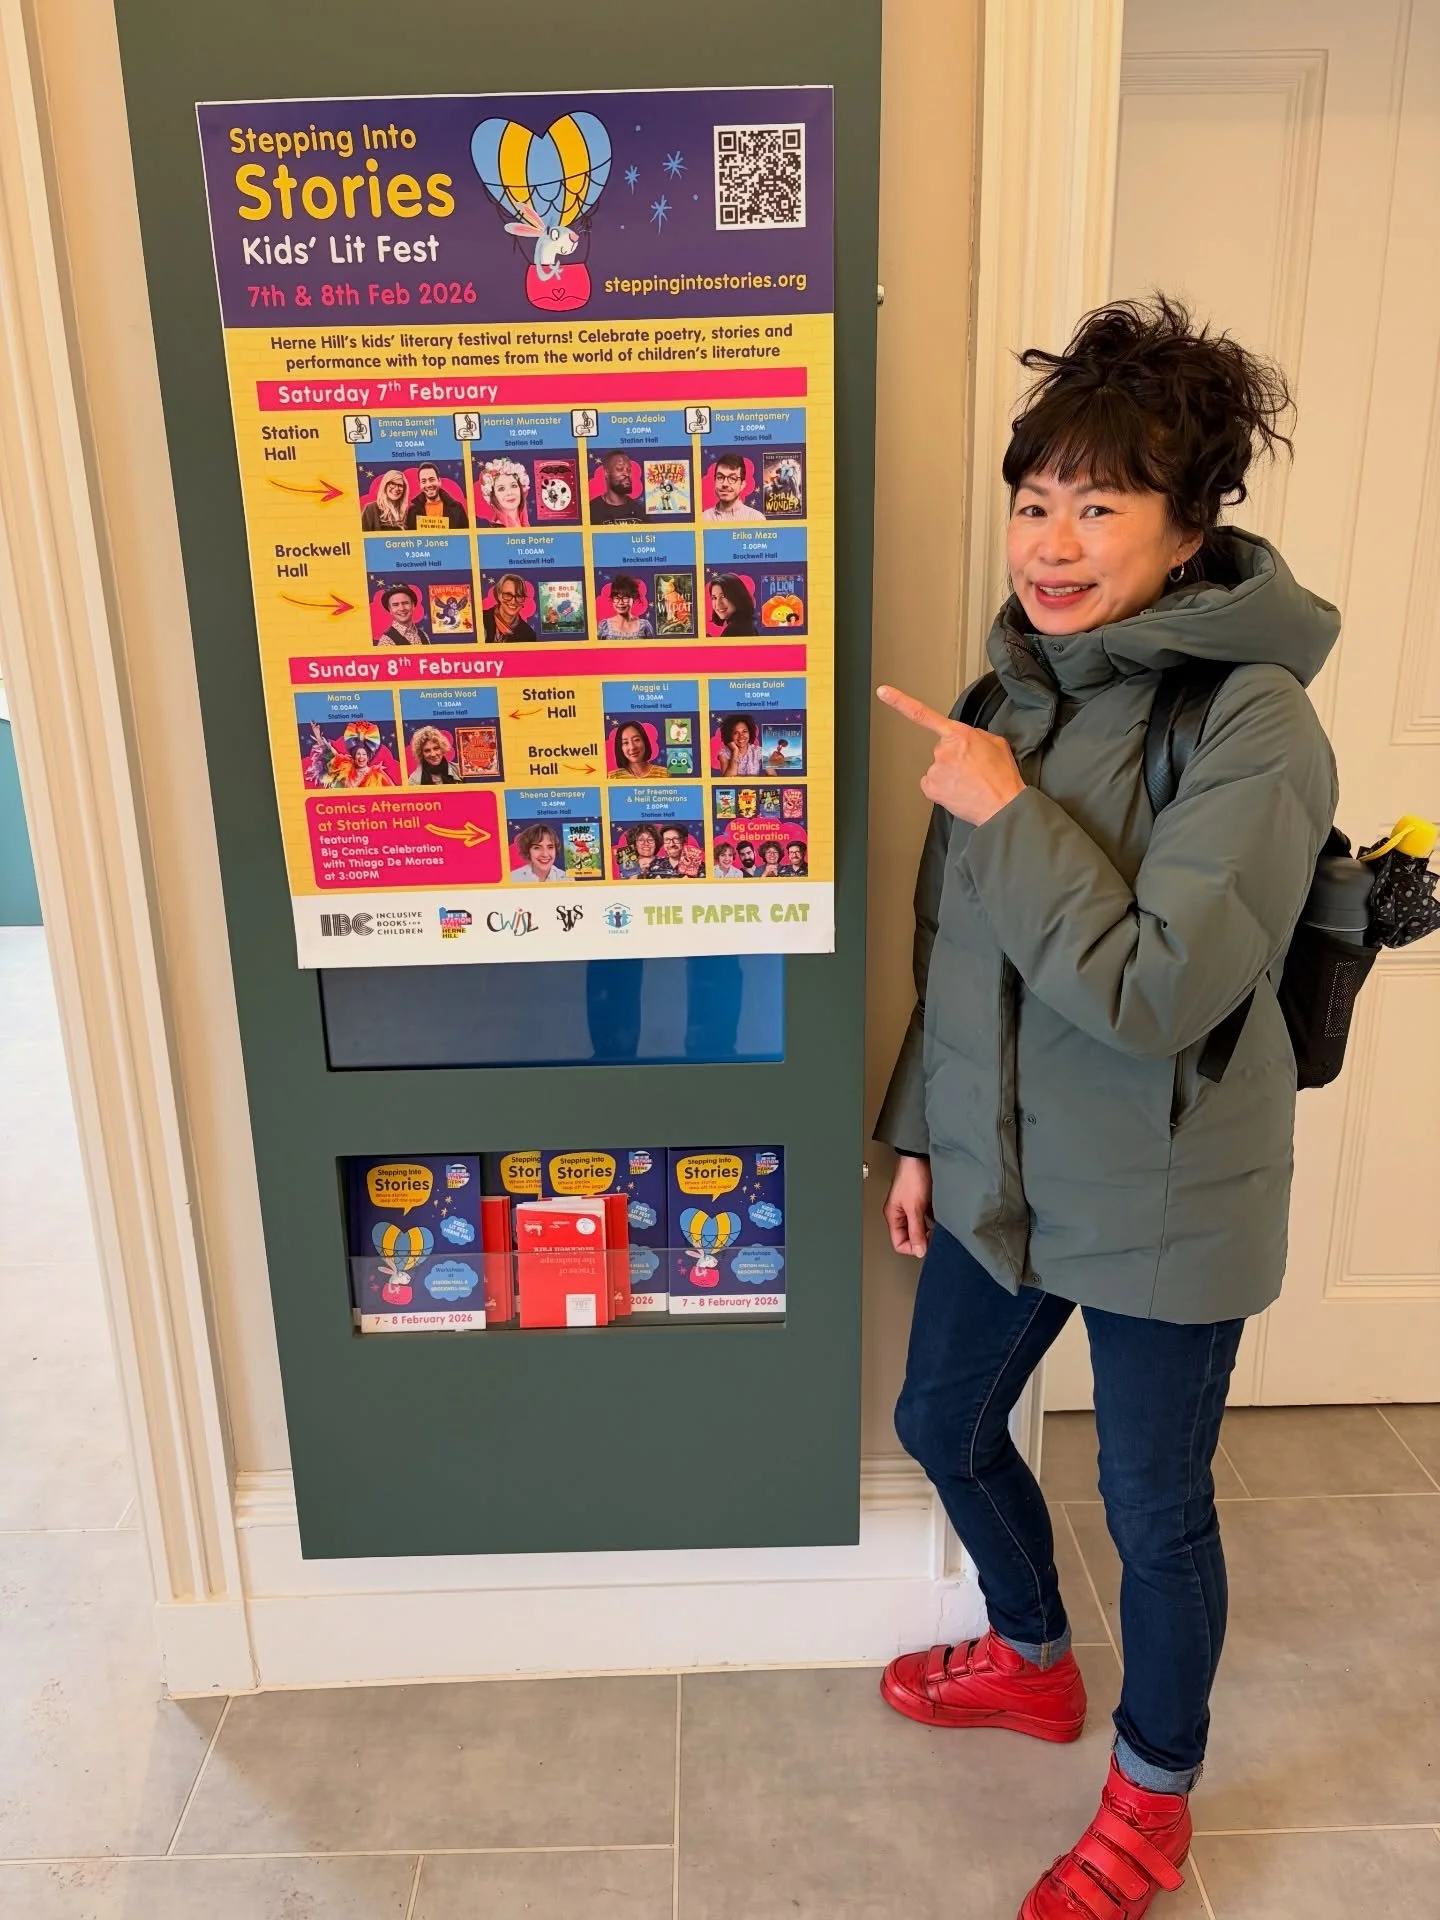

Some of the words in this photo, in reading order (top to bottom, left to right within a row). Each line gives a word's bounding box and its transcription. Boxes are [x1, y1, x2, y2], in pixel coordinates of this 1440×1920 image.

[230, 125, 354, 158] Stepping
[363, 124, 416, 149] Into
[235, 158, 455, 220] Stories
[243, 235, 316, 264] Kids'
[330, 235, 365, 263] Lit
[377, 235, 439, 262] Fest
[605, 272, 806, 295] steppingintostories.org
[248, 285, 285, 307] 7th
[295, 286, 311, 306] &
[321, 284, 360, 305] 8th
[369, 283, 410, 305] Feb
[419, 283, 477, 304] 2026
[271, 336, 316, 349] Herne
[321, 335, 357, 349] Hill's
[362, 335, 395, 347] kids'
[401, 334, 453, 349] literary
[458, 333, 511, 346] festival
[516, 330, 573, 344] returns!
[578, 328, 649, 343] Celebrate
[654, 327, 706, 343] poetry,
[711, 326, 760, 339] stories
[765, 323, 793, 336] and
[286, 355, 381, 372] performance
[386, 355, 417, 367] with
[422, 355, 446, 369] top
[452, 354, 500, 365] names
[505, 350, 538, 364] from
[544, 350, 567, 363] the
[572, 349, 613, 362] world
[618, 348, 632, 362] of
[638, 347, 707, 361] children's
[713, 345, 780, 358] literature
[279, 385, 369, 405] Saturday
[377, 381, 401, 401] 7th
[410, 384, 498, 402] February
[379, 419, 403, 427] Emma
[516, 417, 561, 425] Muncaster
[611, 416, 633, 425] Dapo
[737, 413, 790, 422] Montgomery
[262, 426, 319, 440] Station
[389, 429, 418, 438] Jeremy
[421, 428, 437, 436] Weil
[265, 447, 296, 461] Hall
[646, 535, 655, 543] Sit
[755, 531, 777, 539] Meza
[275, 542, 350, 557] Brockwell
[417, 540, 422, 548] P
[424, 539, 448, 548] Jones
[278, 564, 308, 577] Hall
[309, 661, 379, 680] Sunday
[388, 657, 411, 675] 8th
[419, 659, 504, 676] February
[523, 688, 575, 701] Station
[632, 684, 660, 692] Maggie
[548, 705, 576, 718] Hall
[529, 744, 597, 757] Brockwell
[530, 763, 558, 775] Hall
[316, 802, 366, 815] Comics
[371, 801, 441, 813] Afternoon
[318, 821, 332, 831] at
[337, 819, 387, 831] Station
[393, 817, 420, 828] Hall
[731, 823, 744, 832] Big
[320, 835, 369, 845] featuring
[733, 832, 789, 841] Celebration
[322, 848, 338, 858] Big
[342, 847, 379, 856] Comics
[382, 844, 443, 854] Celebration
[323, 860, 345, 869] with
[349, 859, 384, 869] Thiago
[388, 858, 401, 866] De
[405, 857, 444, 865] Moraes
[325, 872, 336, 880] at
[339, 871, 379, 880] 3:00PM
[644, 905, 683, 925] THE
[692, 904, 762, 924] PAPER
[770, 903, 810, 923] CAT
[509, 1166, 541, 1178] Stor
[558, 1165, 612, 1179] Stories
[685, 1165, 738, 1179] Stories
[375, 1178, 429, 1191] Stories
[631, 1296, 653, 1304] 2026
[700, 1298, 704, 1306] 8
[709, 1298, 750, 1307] February
[755, 1297, 778, 1305] 2026
[375, 1317, 380, 1325] 7
[392, 1316, 397, 1324] 8
[402, 1315, 445, 1324] February
[449, 1314, 472, 1322] 2026
